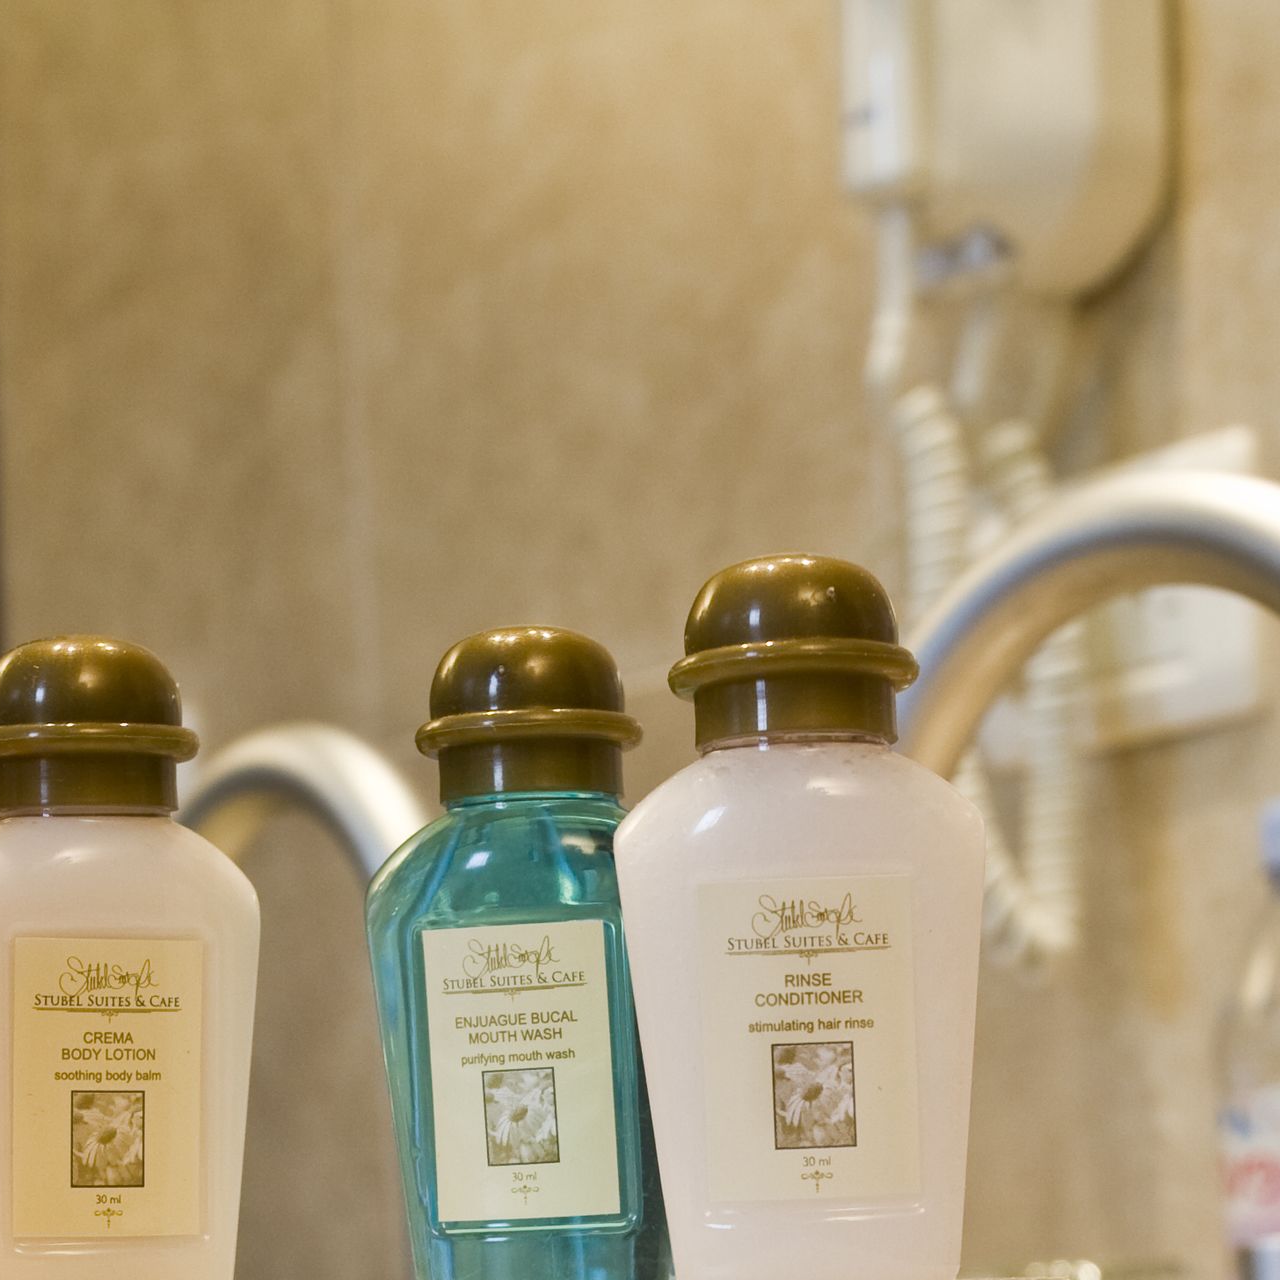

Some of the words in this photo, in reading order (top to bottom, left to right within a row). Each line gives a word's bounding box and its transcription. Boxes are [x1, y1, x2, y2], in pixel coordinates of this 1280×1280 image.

[727, 937, 778, 951] STUBEL
[784, 934, 832, 949] SUITES
[837, 932, 849, 947] &
[854, 932, 889, 946] CAFE
[443, 976, 485, 990] STUBEL
[490, 974, 533, 987] SUITES
[537, 971, 548, 984] &
[552, 970, 586, 984] CAFE
[784, 973, 832, 988] RINSE
[34, 994, 83, 1007] STUBEL
[87, 994, 131, 1008] SUITES
[136, 994, 146, 1008] &
[149, 994, 180, 1008] CAFE
[755, 990, 863, 1007] CONDITIONER
[455, 1013, 527, 1029] ENJUAGUE
[531, 1010, 578, 1025] BUCAL
[748, 1018, 815, 1034] stimulating
[817, 1017, 842, 1031] hair
[844, 1016, 874, 1030] rinse
[83, 1032, 134, 1044] CREMA
[468, 1030, 517, 1045] MOUTH
[521, 1027, 563, 1041] WASH
[62, 1049, 102, 1061] BODY
[105, 1049, 156, 1061] LOTION
[461, 1052, 505, 1067] purifying
[509, 1050, 543, 1063] mouth
[546, 1048, 576, 1060] wash
[54, 1070, 102, 1084] soothing
[105, 1070, 133, 1083] body
[136, 1070, 161, 1081] balm
[802, 1156, 816, 1167] 30
[819, 1155, 831, 1167] ml
[512, 1172, 525, 1182] 30
[527, 1171, 537, 1182] ml
[95, 1194, 107, 1205] 30
[110, 1194, 122, 1204] ml
